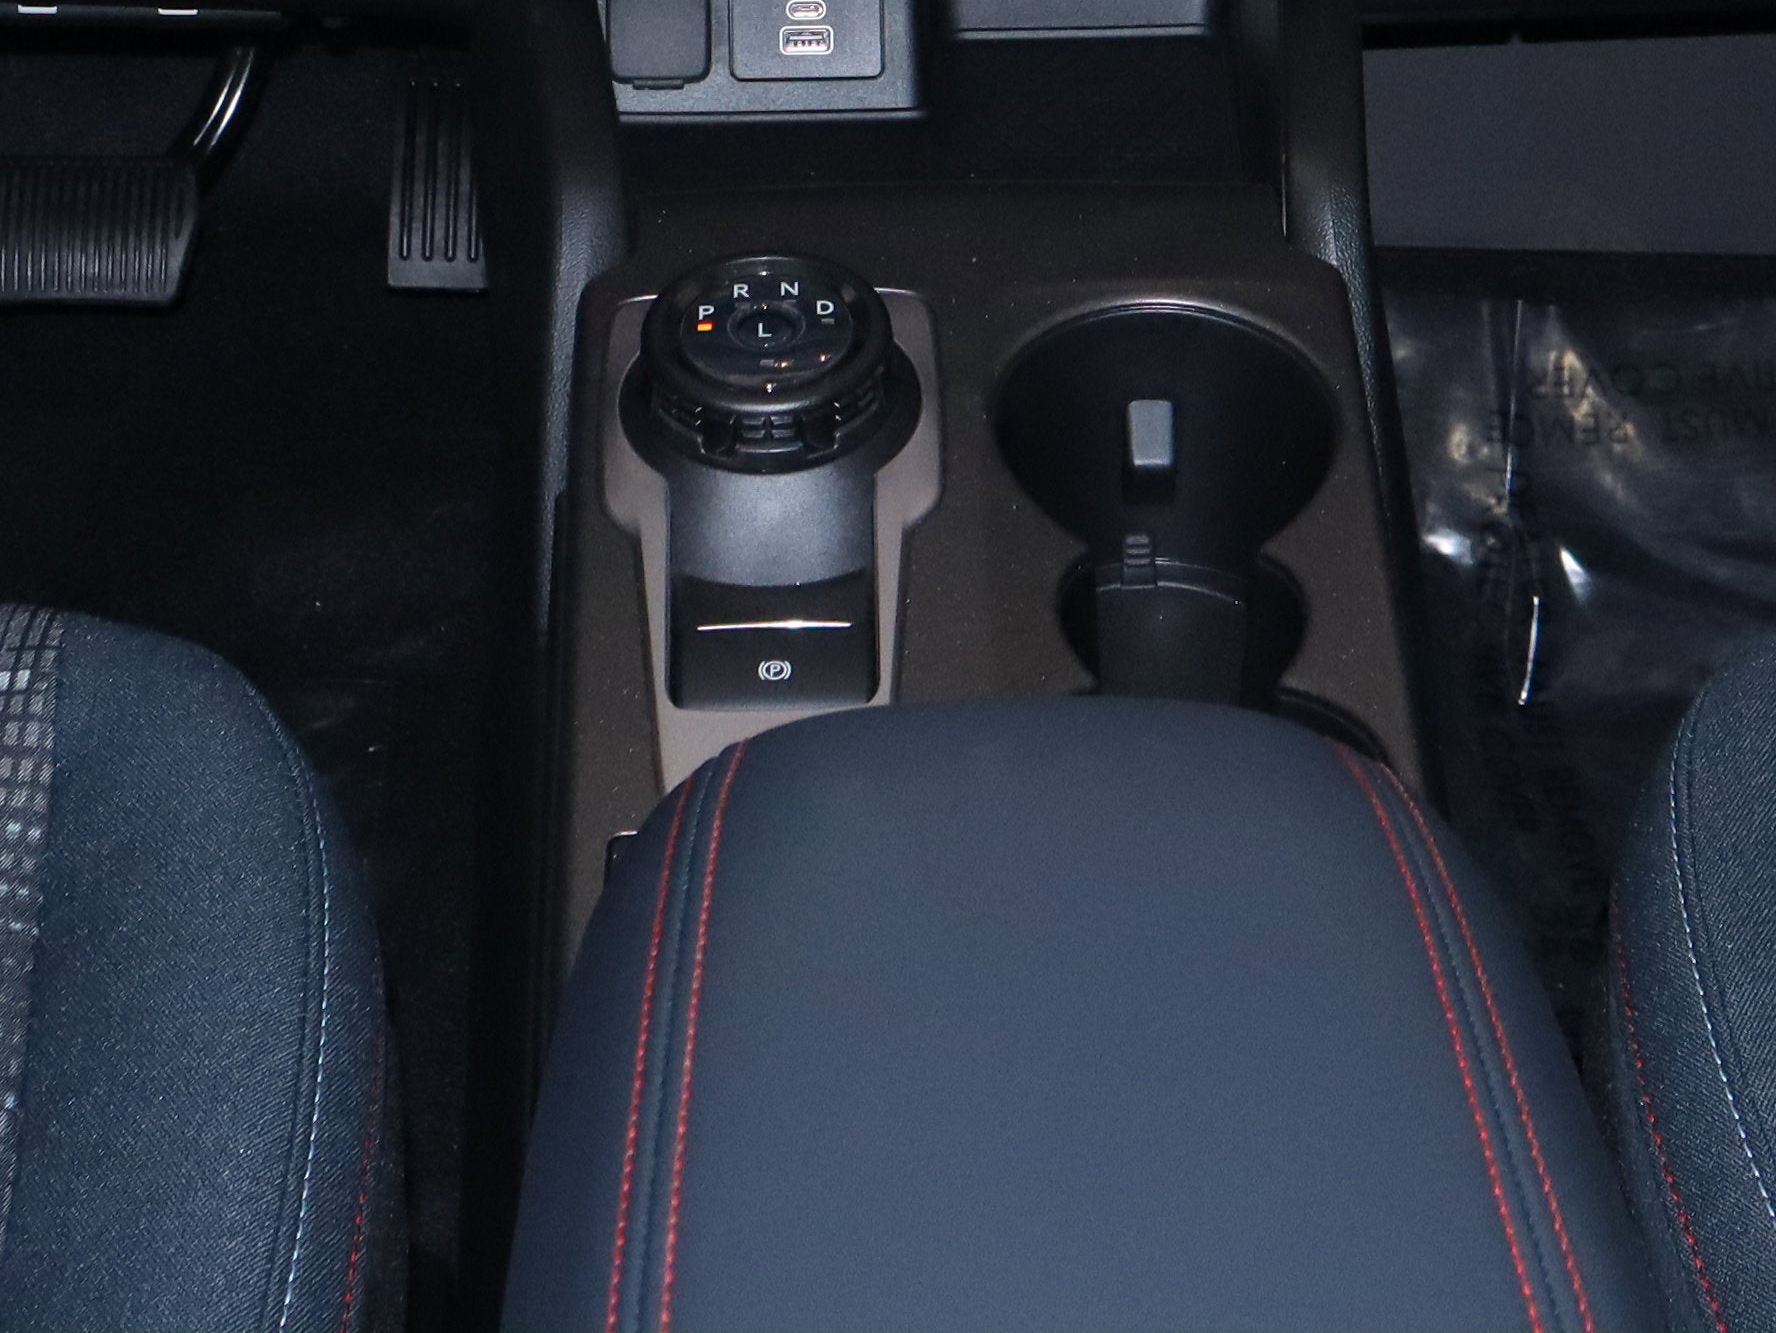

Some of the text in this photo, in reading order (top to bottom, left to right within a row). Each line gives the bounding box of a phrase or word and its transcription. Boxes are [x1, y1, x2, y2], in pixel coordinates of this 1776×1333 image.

[732, 281, 799, 299] R N
[698, 300, 835, 320] P D
[757, 322, 772, 338] L
[1659, 405, 1772, 441] MUST
